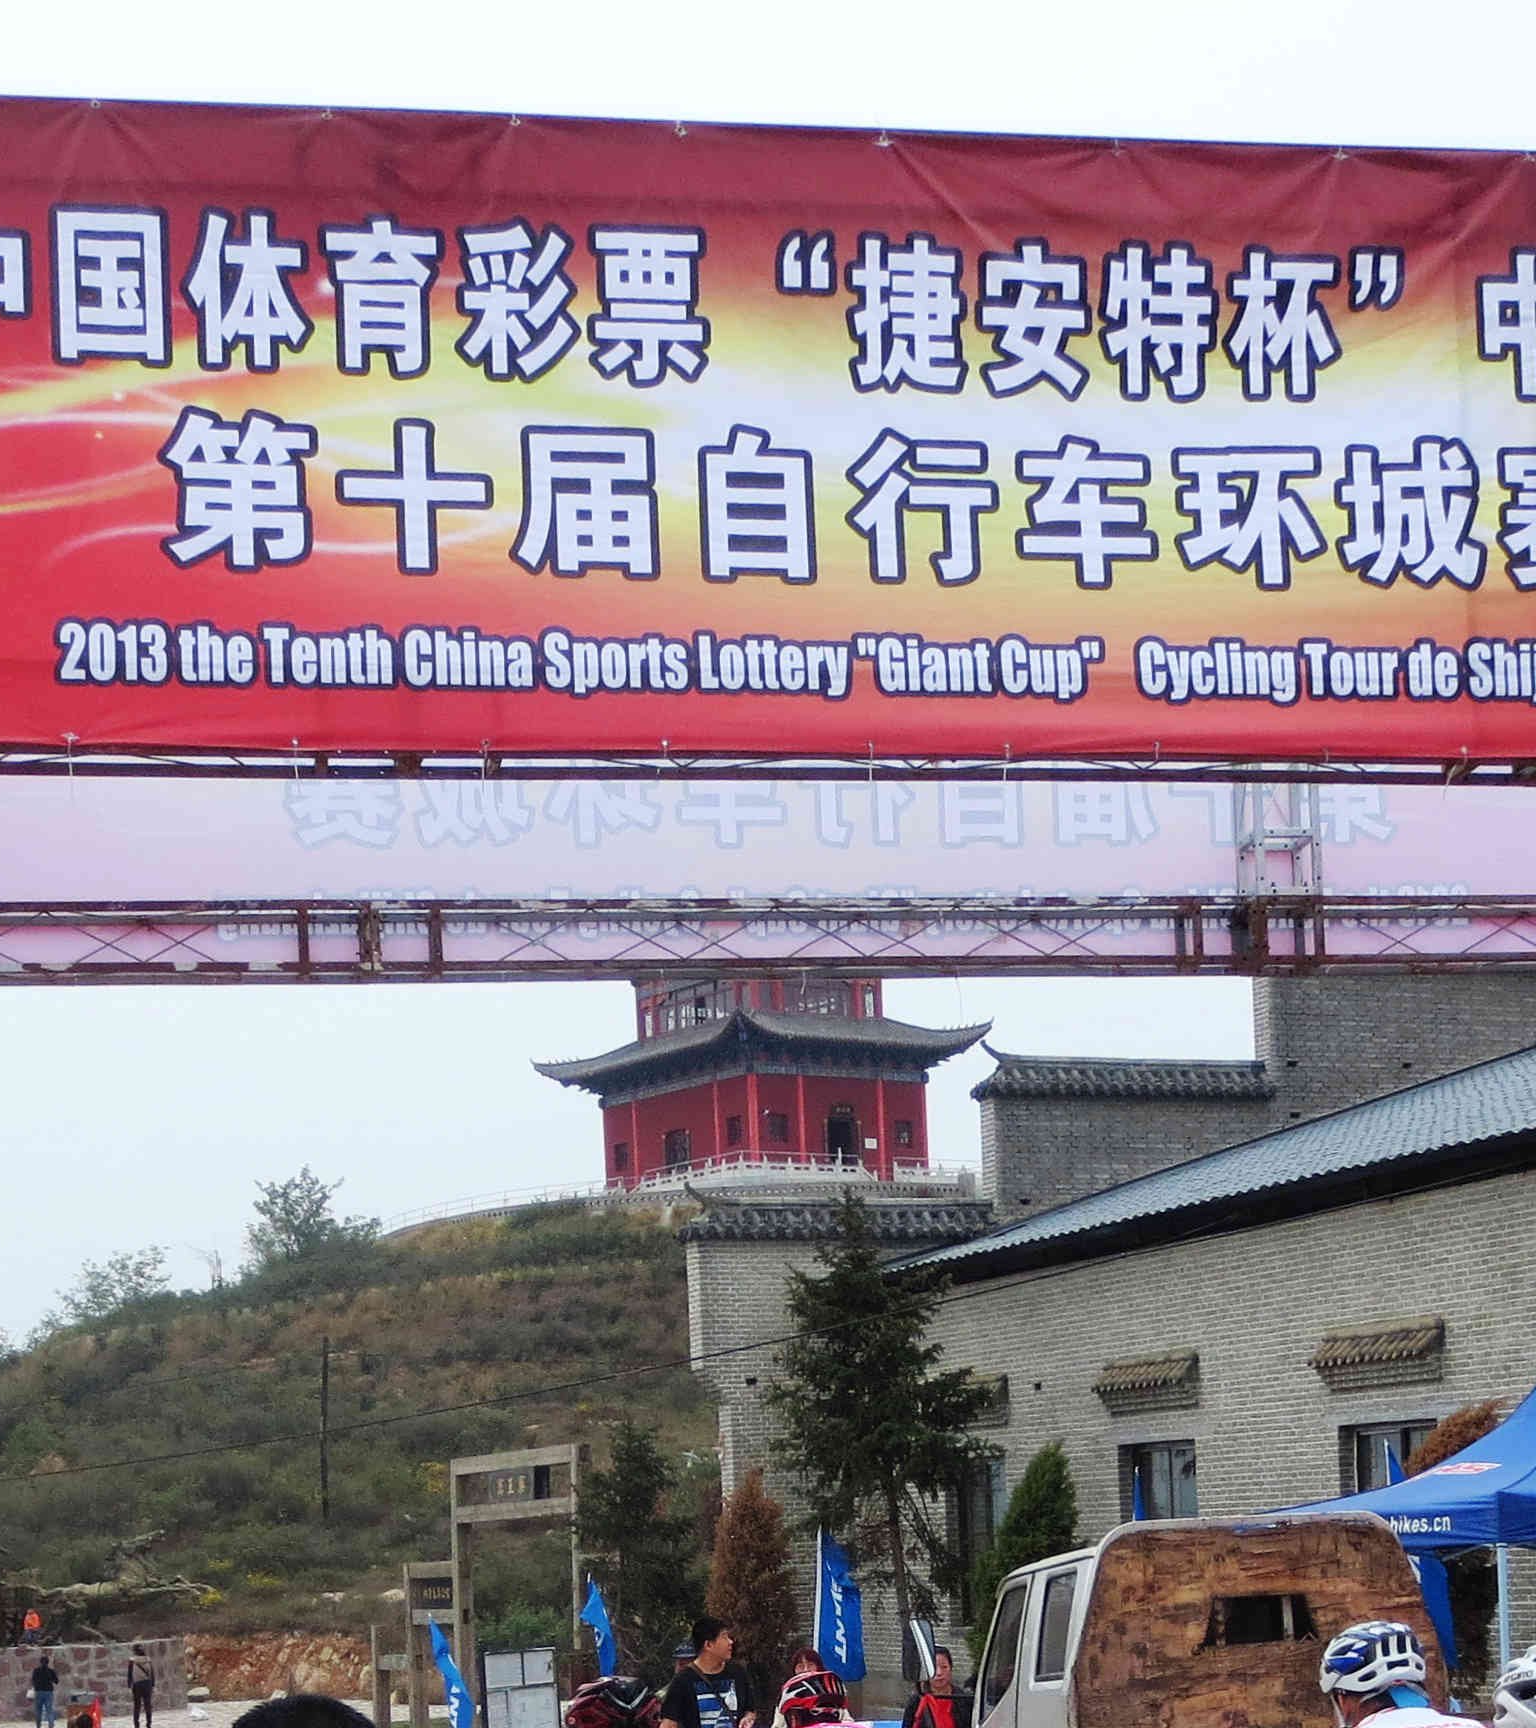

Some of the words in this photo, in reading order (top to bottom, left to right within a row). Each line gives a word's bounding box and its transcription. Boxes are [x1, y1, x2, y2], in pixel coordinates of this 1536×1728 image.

[60, 623, 168, 683] 2013
[179, 627, 254, 684] the
[264, 629, 393, 687] Tenth
[404, 630, 534, 690] China
[545, 634, 689, 697] Sports
[698, 634, 850, 699] Lottery
[856, 638, 993, 694] "Giant
[999, 638, 1102, 700] Cup"
[1138, 641, 1297, 702] Cycling
[1302, 643, 1398, 696] Tour
[1407, 643, 1458, 697] de
